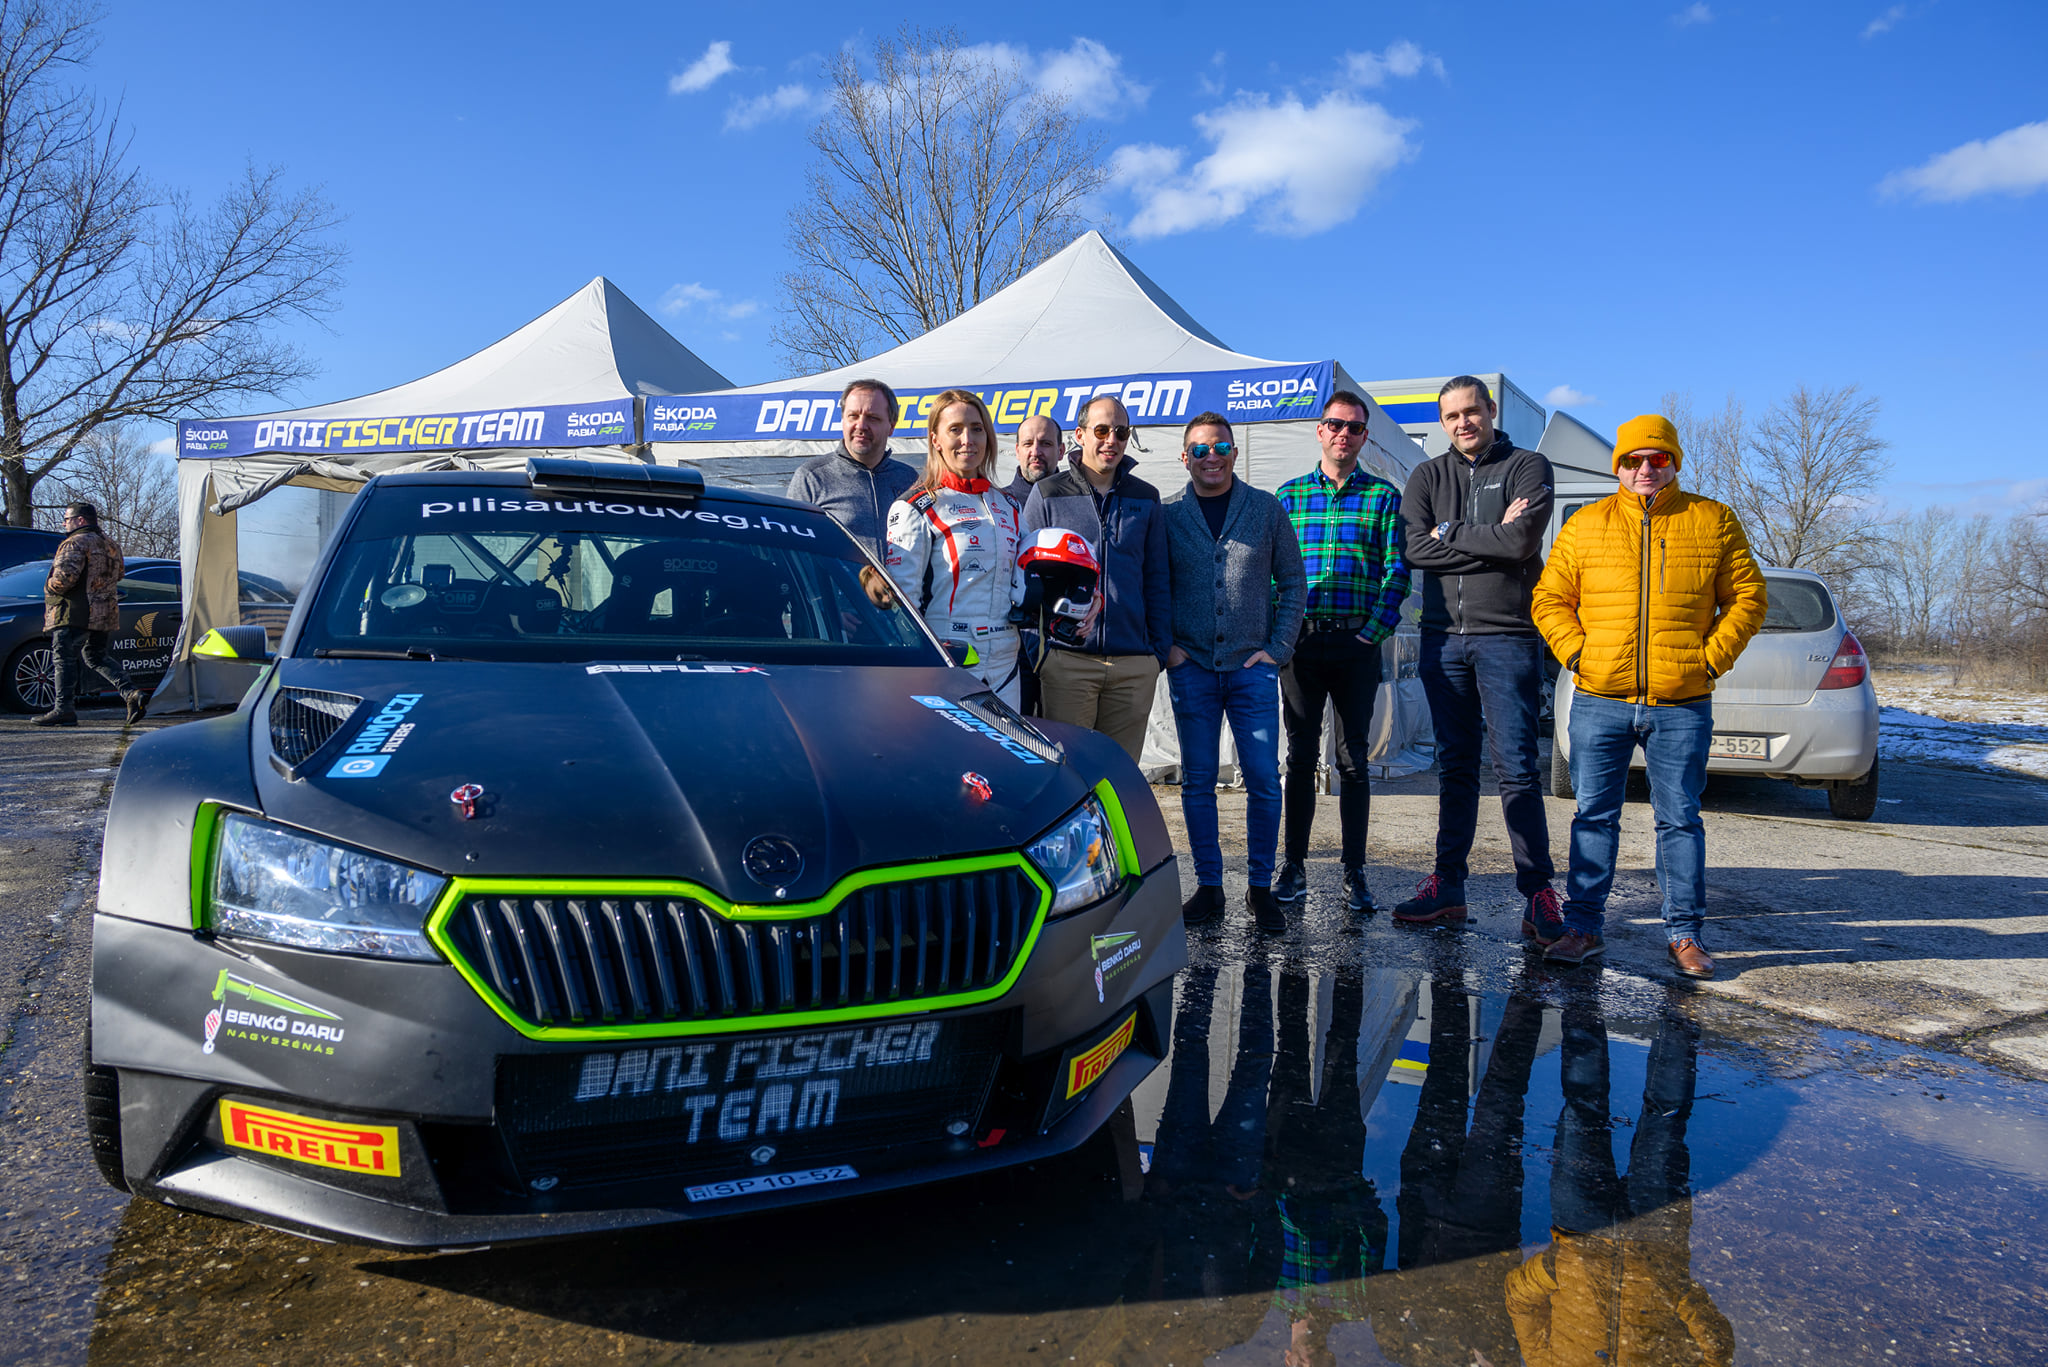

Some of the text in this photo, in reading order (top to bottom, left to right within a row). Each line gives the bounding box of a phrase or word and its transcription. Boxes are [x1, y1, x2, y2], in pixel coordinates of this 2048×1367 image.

[1227, 377, 1318, 398] ŠKODA
[1227, 395, 1318, 411] FABIA RS
[567, 411, 625, 427] ŠKODA
[654, 405, 717, 421] ŠKODA
[185, 428, 229, 441] ŠKODA
[324, 417, 459, 448] FISCHER
[460, 411, 545, 444] TEAM
[567, 426, 625, 437] FABIA RS
[654, 422, 717, 432] FABIA RS
[186, 442, 229, 450] FABIA RS
[422, 497, 816, 538] pilisautouveg.hu
[663, 558, 719, 572] sparco
[444, 592, 477, 605] OMP
[952, 623, 968, 632] OMP
[113, 636, 176, 650] MERCARIUS
[122, 658, 163, 671] PAPPAS
[225, 1008, 345, 1042] BENKŐ DARU
[226, 1028, 335, 1055] NAGYSZÉNÁS
[574, 1020, 942, 1101] DANI FISCHER
[1072, 1019, 1133, 1092] PIRELLI
[683, 1078, 840, 1144] TEAM
[230, 1106, 385, 1171] PIRELLI
[714, 1180, 756, 1196] SP
[763, 1167, 848, 1189] 10-52
